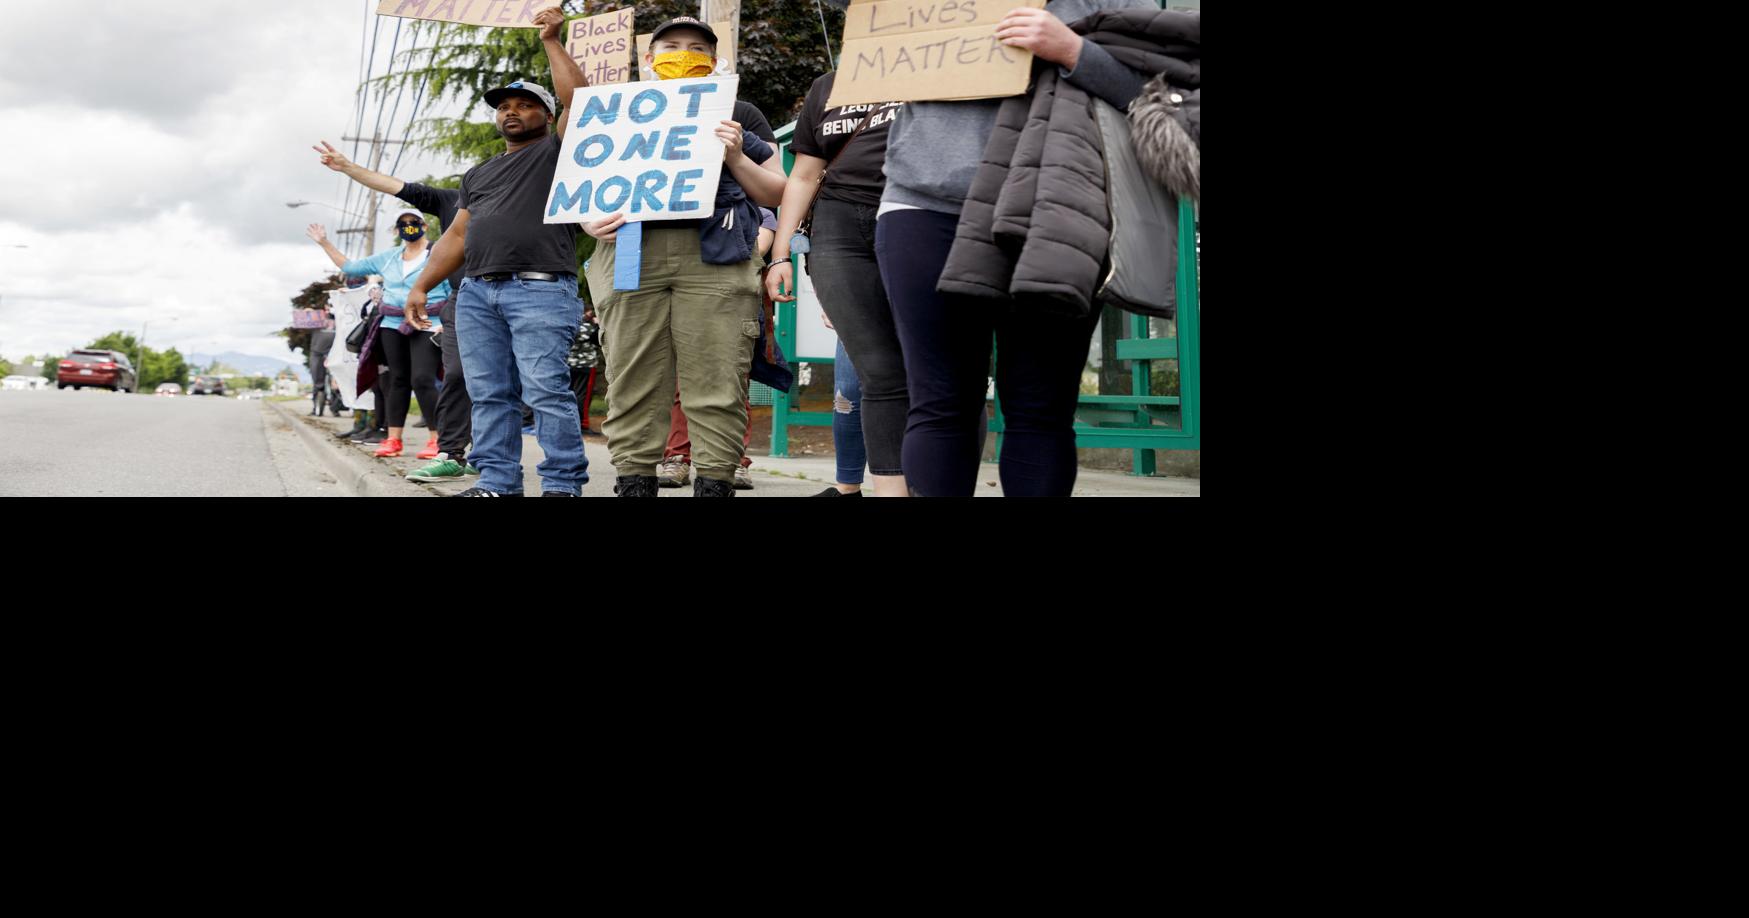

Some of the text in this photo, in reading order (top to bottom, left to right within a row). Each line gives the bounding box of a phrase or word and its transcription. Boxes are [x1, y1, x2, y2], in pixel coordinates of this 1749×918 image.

[572, 12, 629, 39] Black
[869, 0, 978, 33] Lives
[569, 37, 626, 59] Lives
[851, 34, 1015, 81] MATTER
[576, 83, 718, 128] NOT
[822, 117, 866, 136] BEIN
[869, 108, 901, 128] BLA
[573, 125, 698, 168] ONE
[548, 168, 704, 217] MORE
